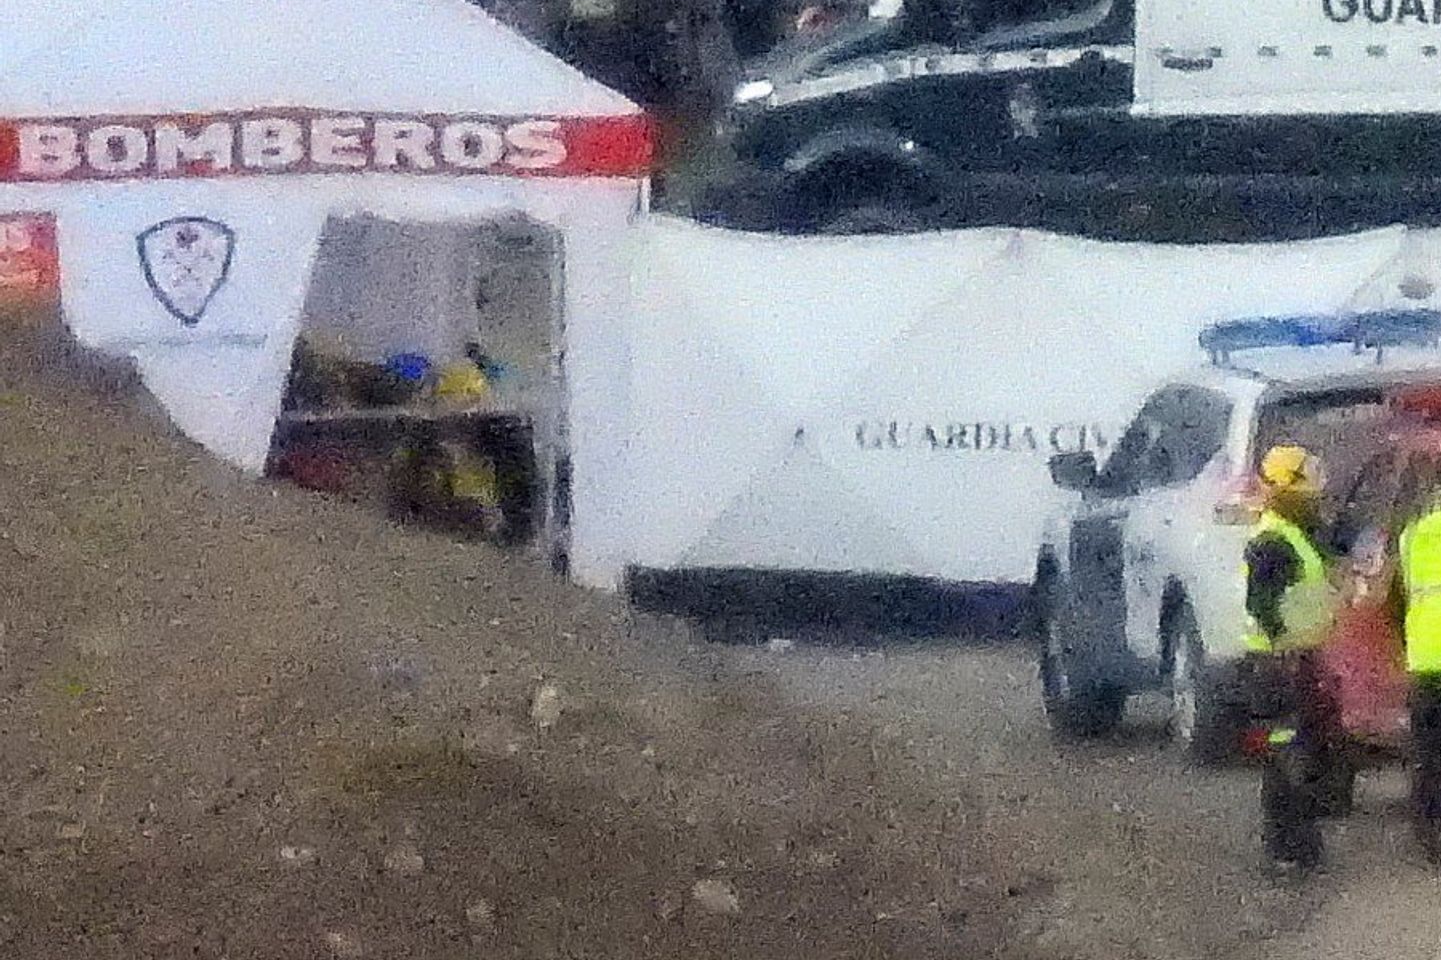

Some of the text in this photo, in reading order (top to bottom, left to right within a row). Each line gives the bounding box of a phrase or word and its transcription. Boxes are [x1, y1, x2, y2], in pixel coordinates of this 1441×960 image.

[17, 116, 568, 176] BOMBEROS
[855, 420, 1118, 453] GUARDIA CIV
